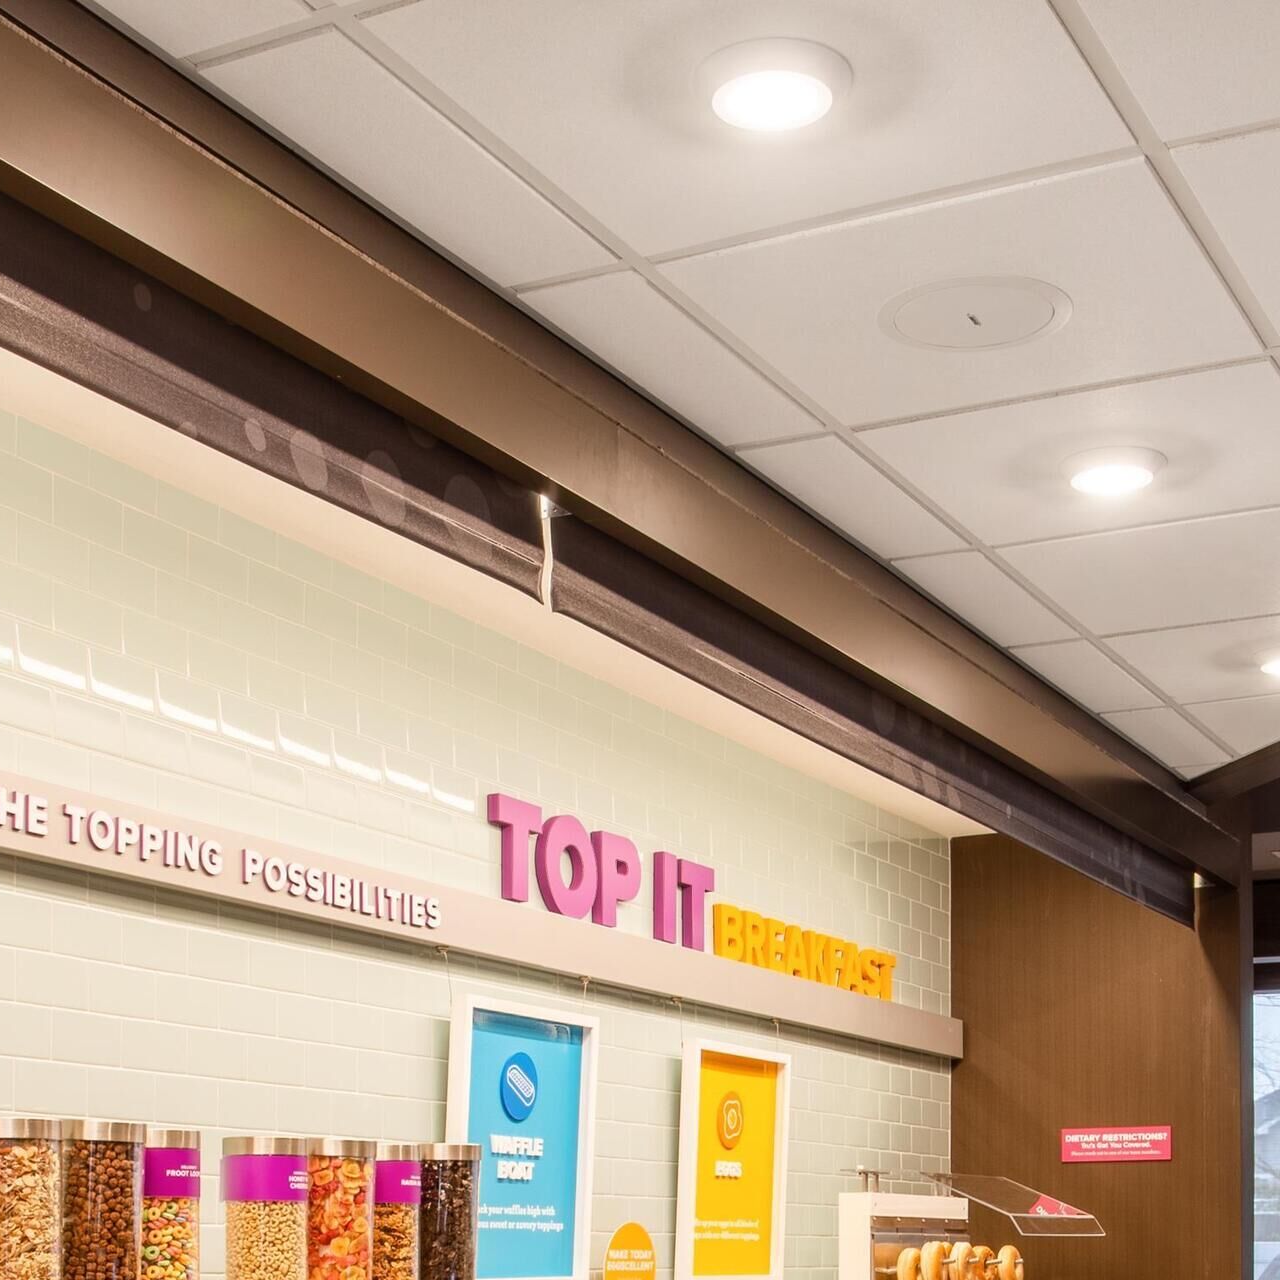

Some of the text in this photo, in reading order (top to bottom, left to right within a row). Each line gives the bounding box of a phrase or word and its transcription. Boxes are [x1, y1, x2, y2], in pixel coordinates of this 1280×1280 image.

[63, 802, 223, 876] TOPPING
[242, 848, 442, 929] POSSIBILITIES
[487, 793, 715, 952] TOP IT
[712, 903, 897, 1000] BREAKFAST
[489, 1134, 544, 1157] WAFFLE
[1065, 1132, 1167, 1143] DIETARY RESTRICTIONS?
[497, 1160, 535, 1180] BOAT
[609, 1249, 652, 1260] MAKE TODAY
